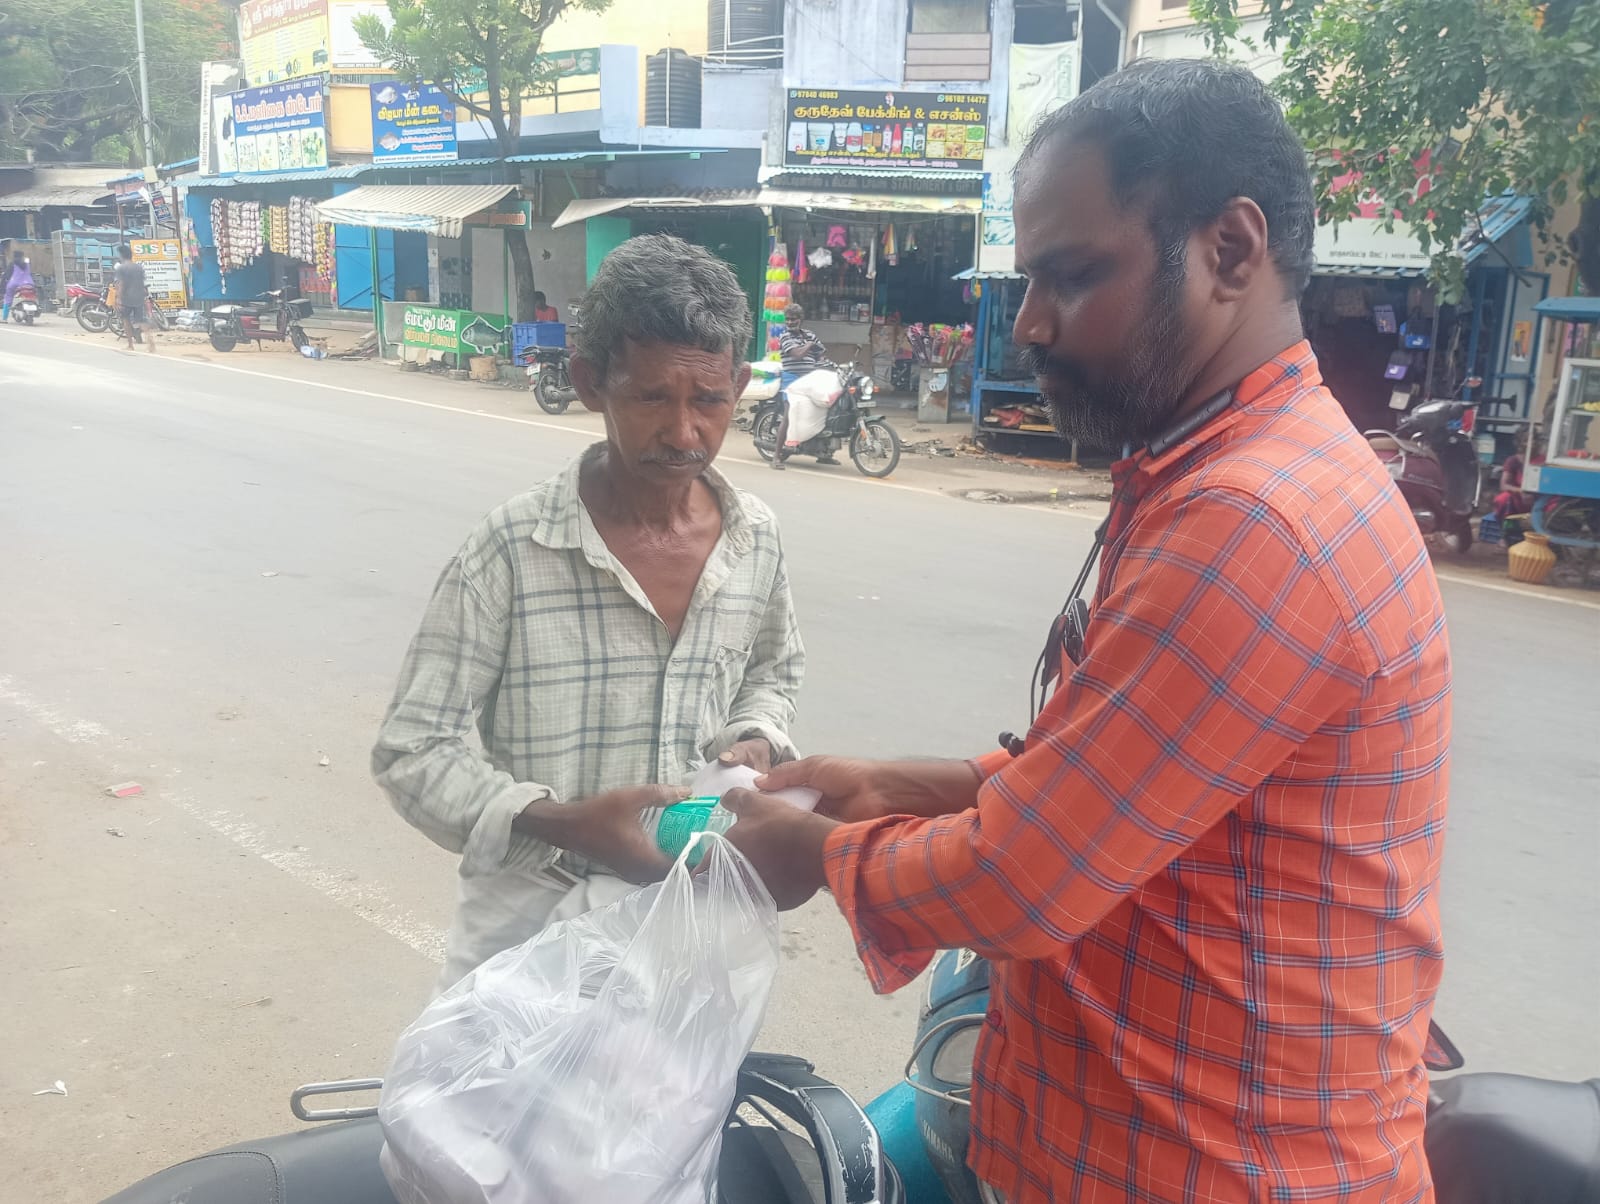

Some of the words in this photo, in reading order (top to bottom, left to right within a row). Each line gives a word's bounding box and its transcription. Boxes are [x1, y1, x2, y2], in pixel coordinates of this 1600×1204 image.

[794, 104, 853, 119] குருதேவ்
[857, 105, 911, 119] பேக்கிங்
[914, 107, 926, 119] &
[929, 107, 981, 121] எசன்ஸ்
[437, 313, 456, 332] மீன்
[923, 1119, 955, 1163] YAMAHA
